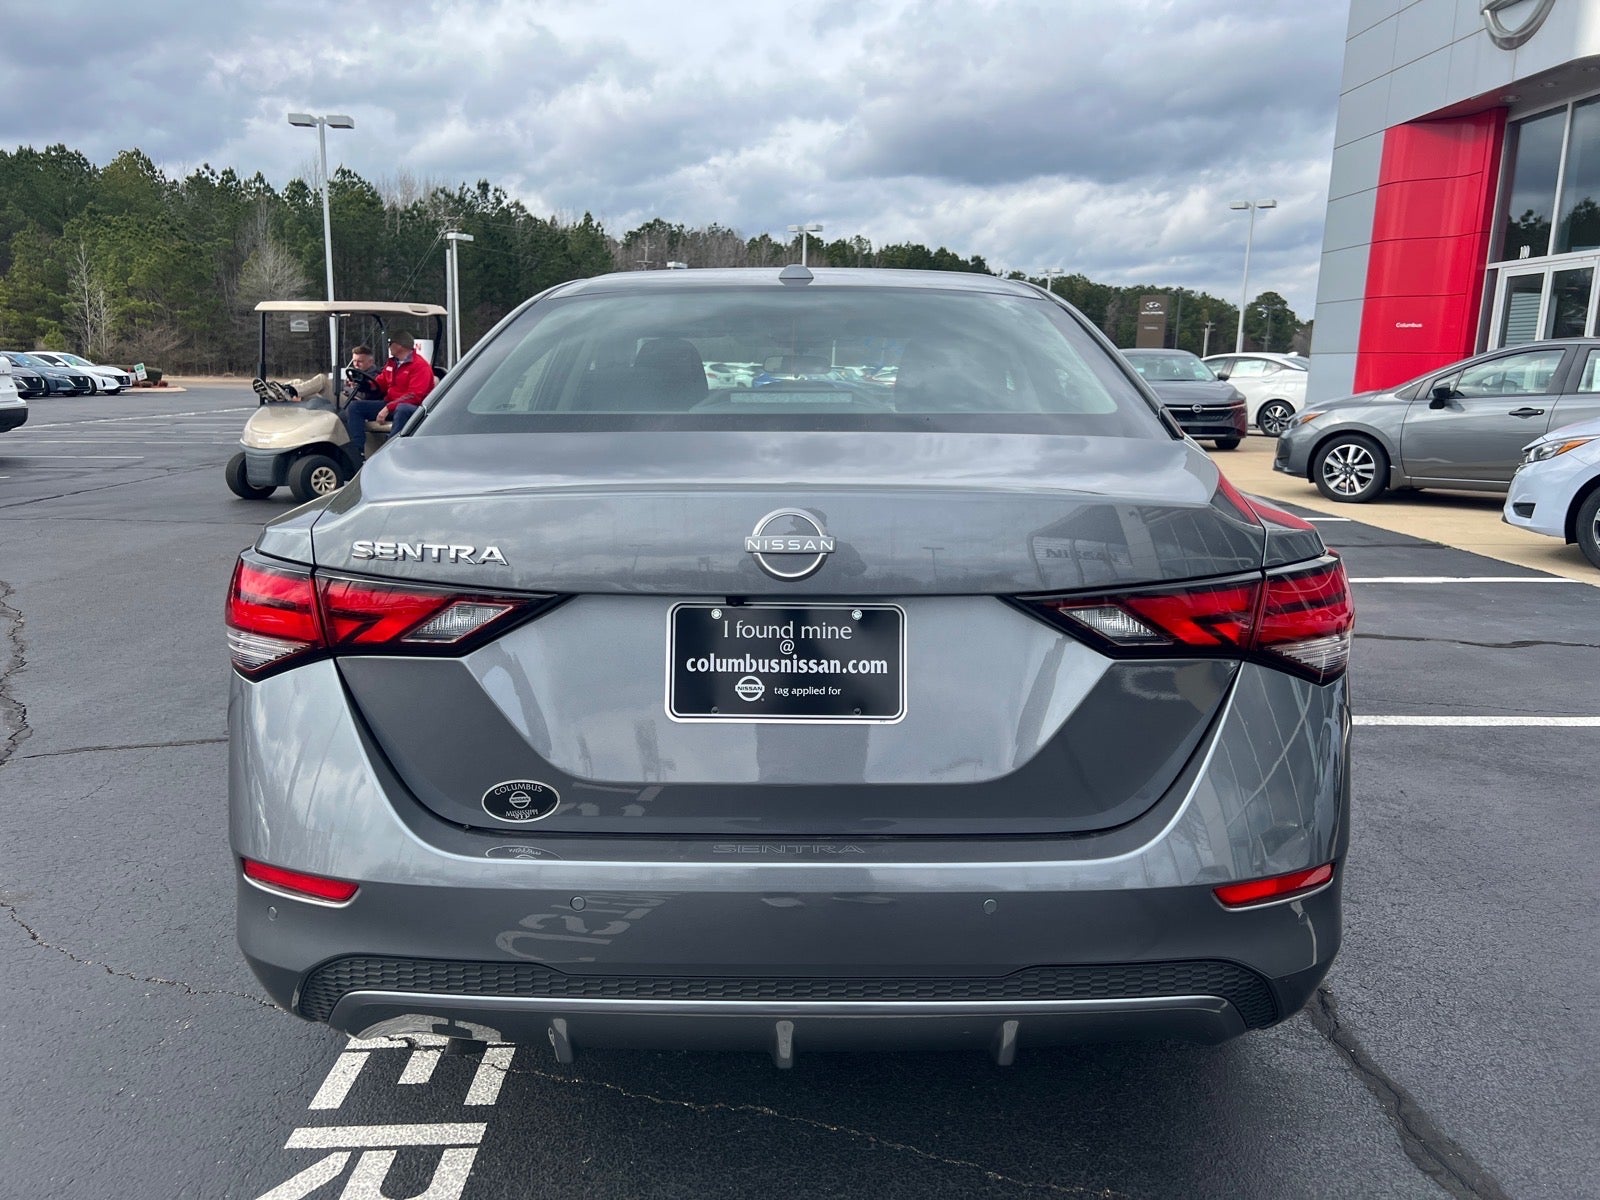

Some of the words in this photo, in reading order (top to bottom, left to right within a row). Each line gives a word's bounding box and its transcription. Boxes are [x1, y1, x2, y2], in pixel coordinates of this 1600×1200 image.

[747, 539, 834, 551] NISSAN
[351, 540, 510, 566] SENTRA
[723, 620, 730, 638] I
[736, 620, 794, 640] found
[800, 622, 853, 640] mine
[779, 639, 795, 655] @
[685, 653, 889, 675] columbusnissan.com
[774, 687, 790, 697] tag
[791, 686, 826, 697] applied
[828, 686, 842, 695] for
[494, 783, 543, 796] COLUMBUS
[712, 843, 866, 855] SENTRA
